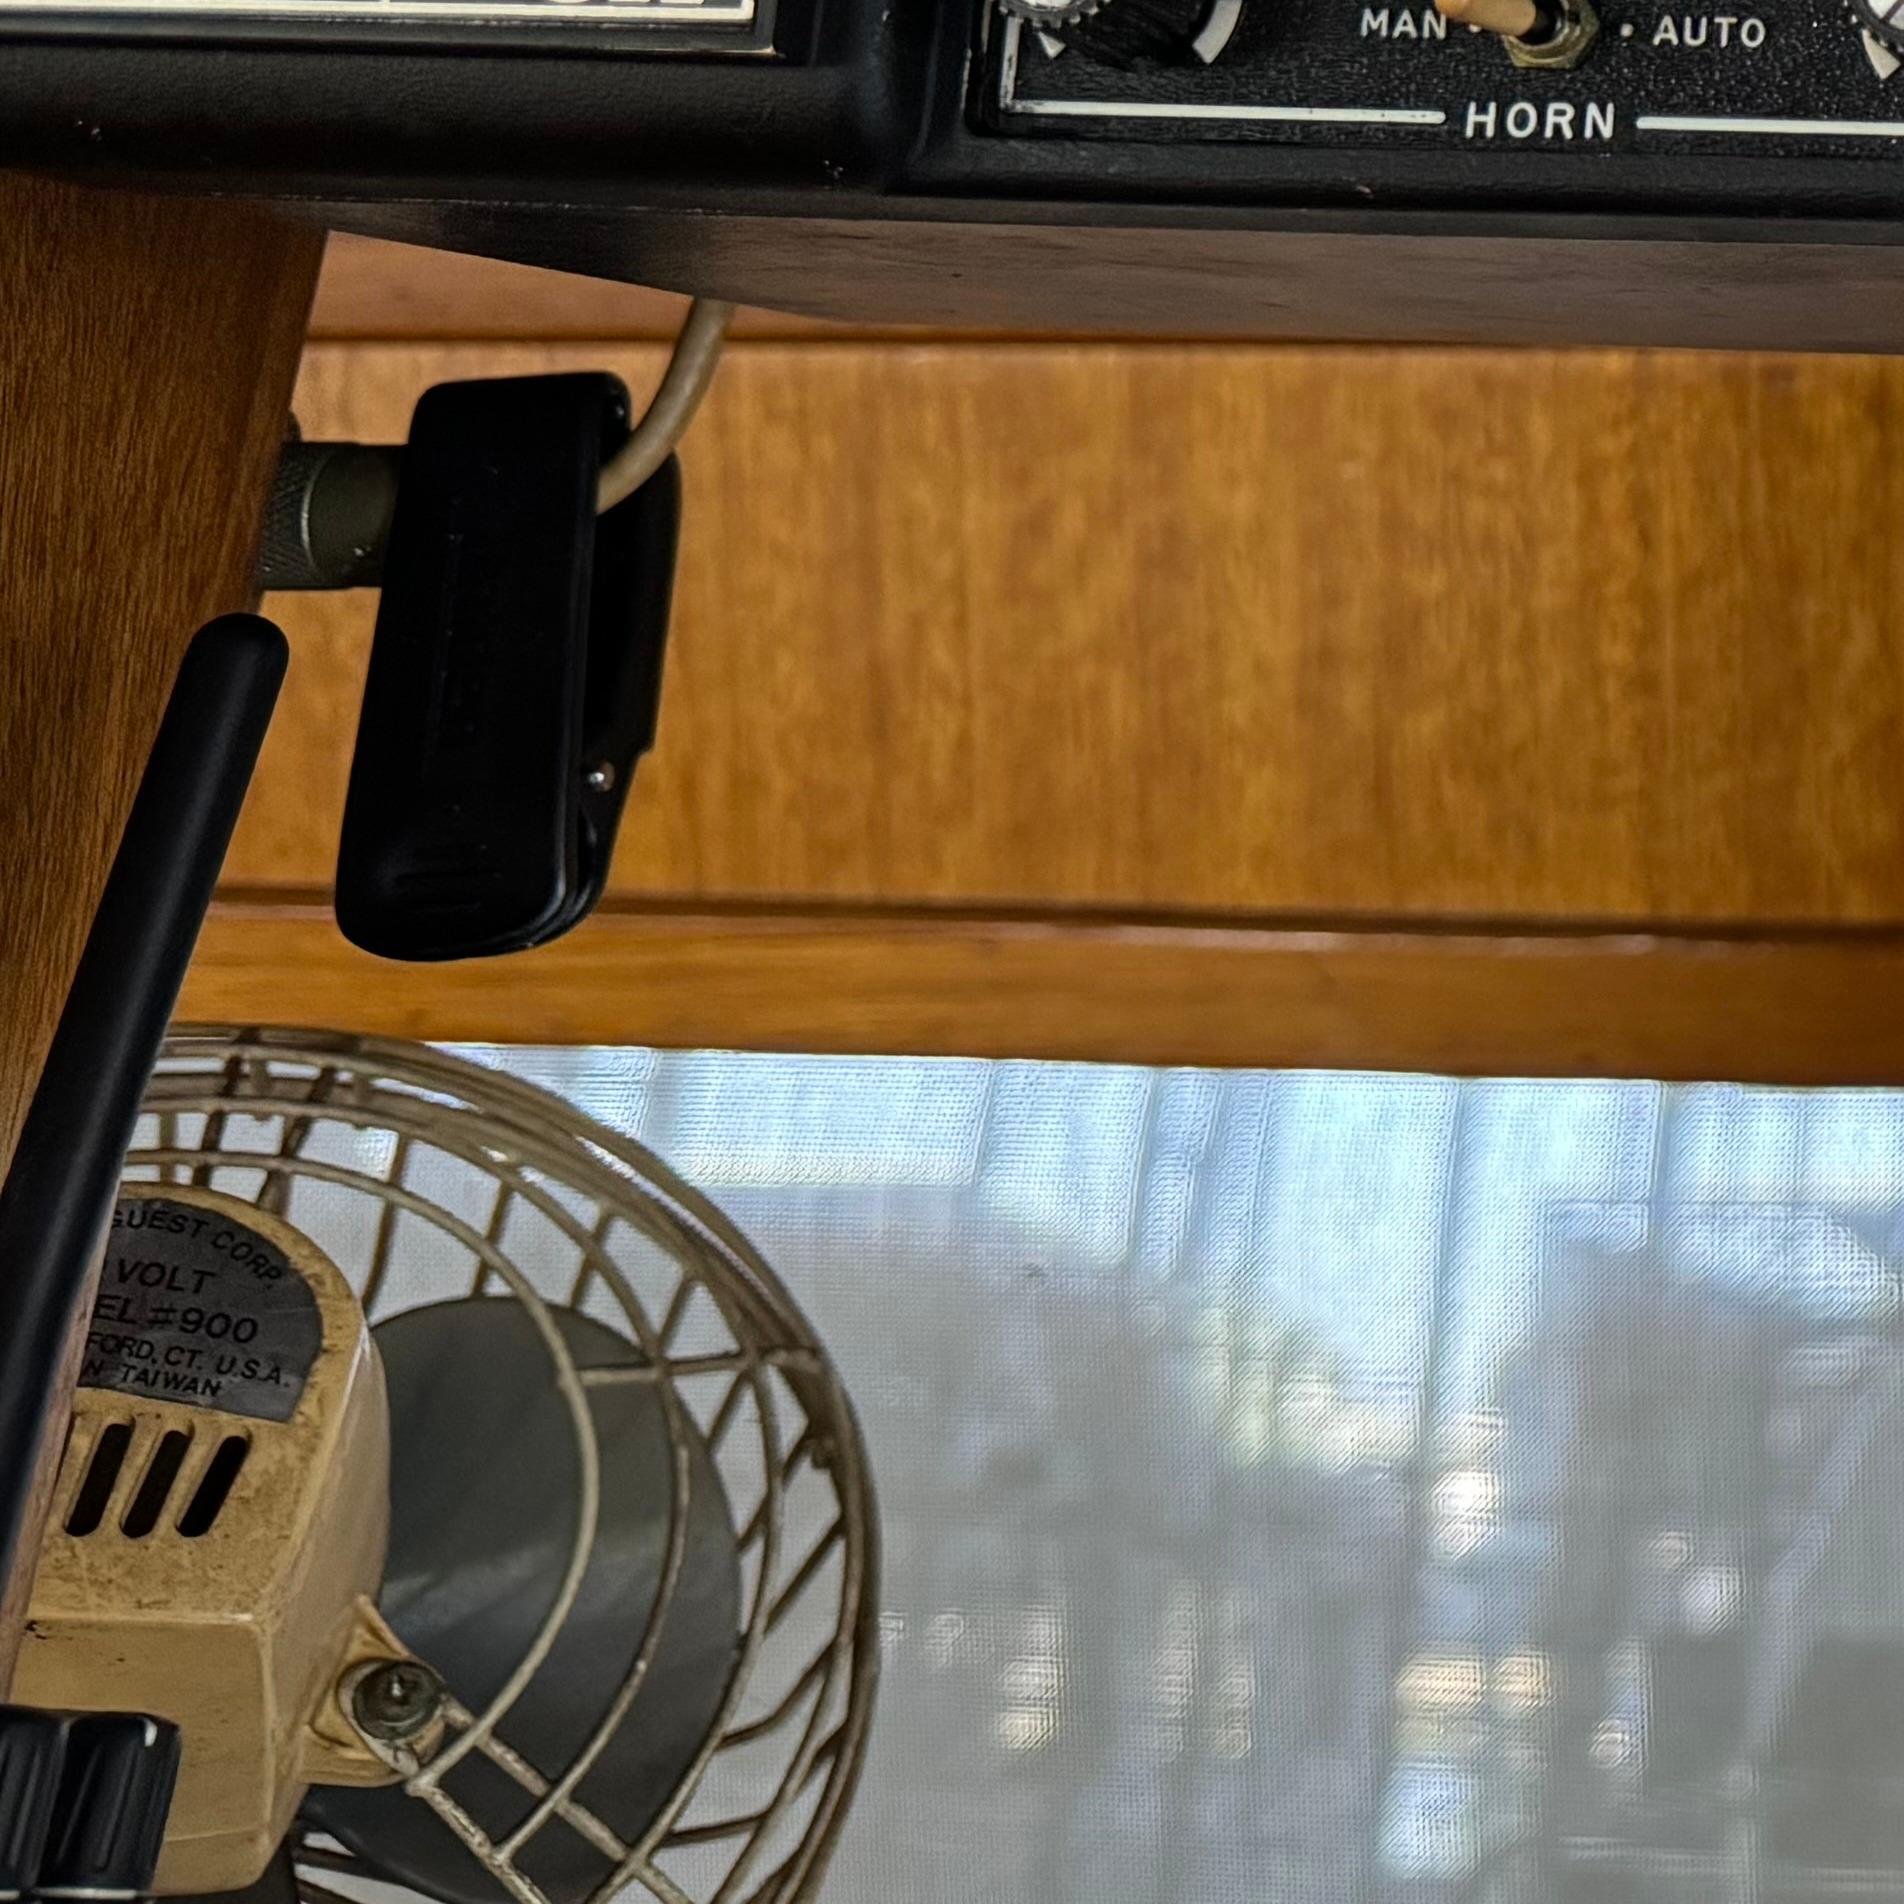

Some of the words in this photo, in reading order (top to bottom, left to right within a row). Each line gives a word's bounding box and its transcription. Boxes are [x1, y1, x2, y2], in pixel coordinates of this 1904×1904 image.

[1360, 8, 1448, 40] MAN
[1652, 15, 1767, 49] AUTO
[1464, 101, 1616, 140] HORN
[117, 1257, 217, 1295] VOLT
[121, 1363, 223, 1398] TAIWAN
